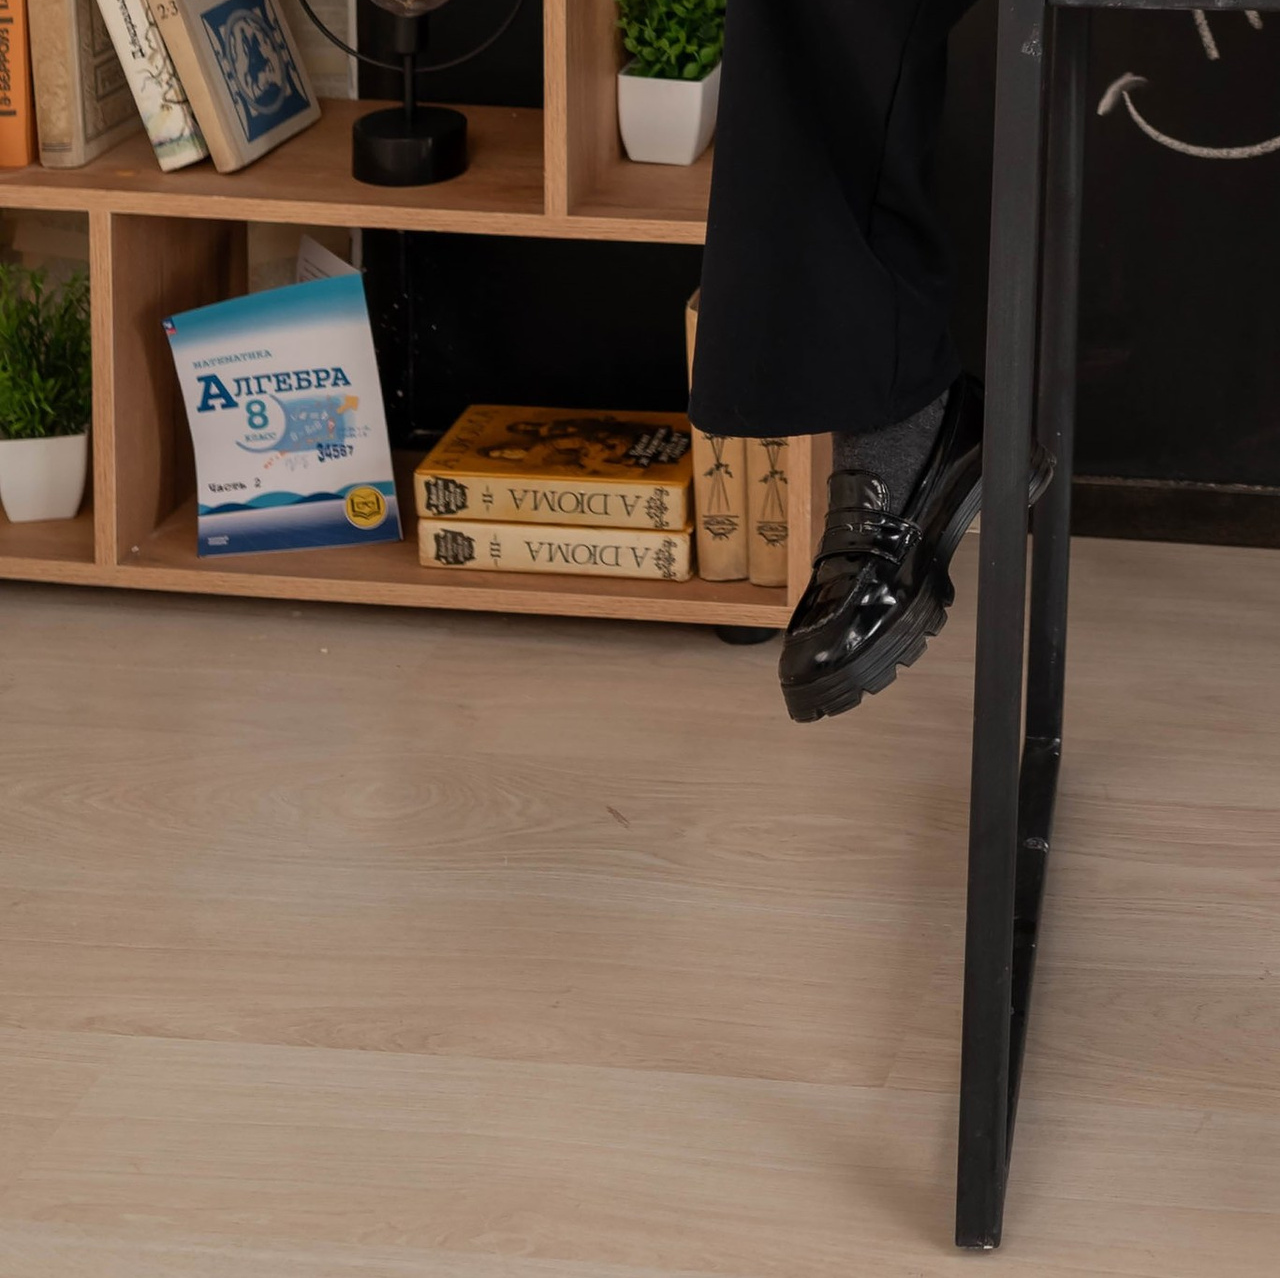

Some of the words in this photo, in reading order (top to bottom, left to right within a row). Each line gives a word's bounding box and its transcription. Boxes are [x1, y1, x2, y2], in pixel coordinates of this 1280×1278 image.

[193, 349, 272, 370] МАТЕМАТИКА
[197, 367, 352, 413] АЛГЕБРА
[245, 399, 270, 430] 8
